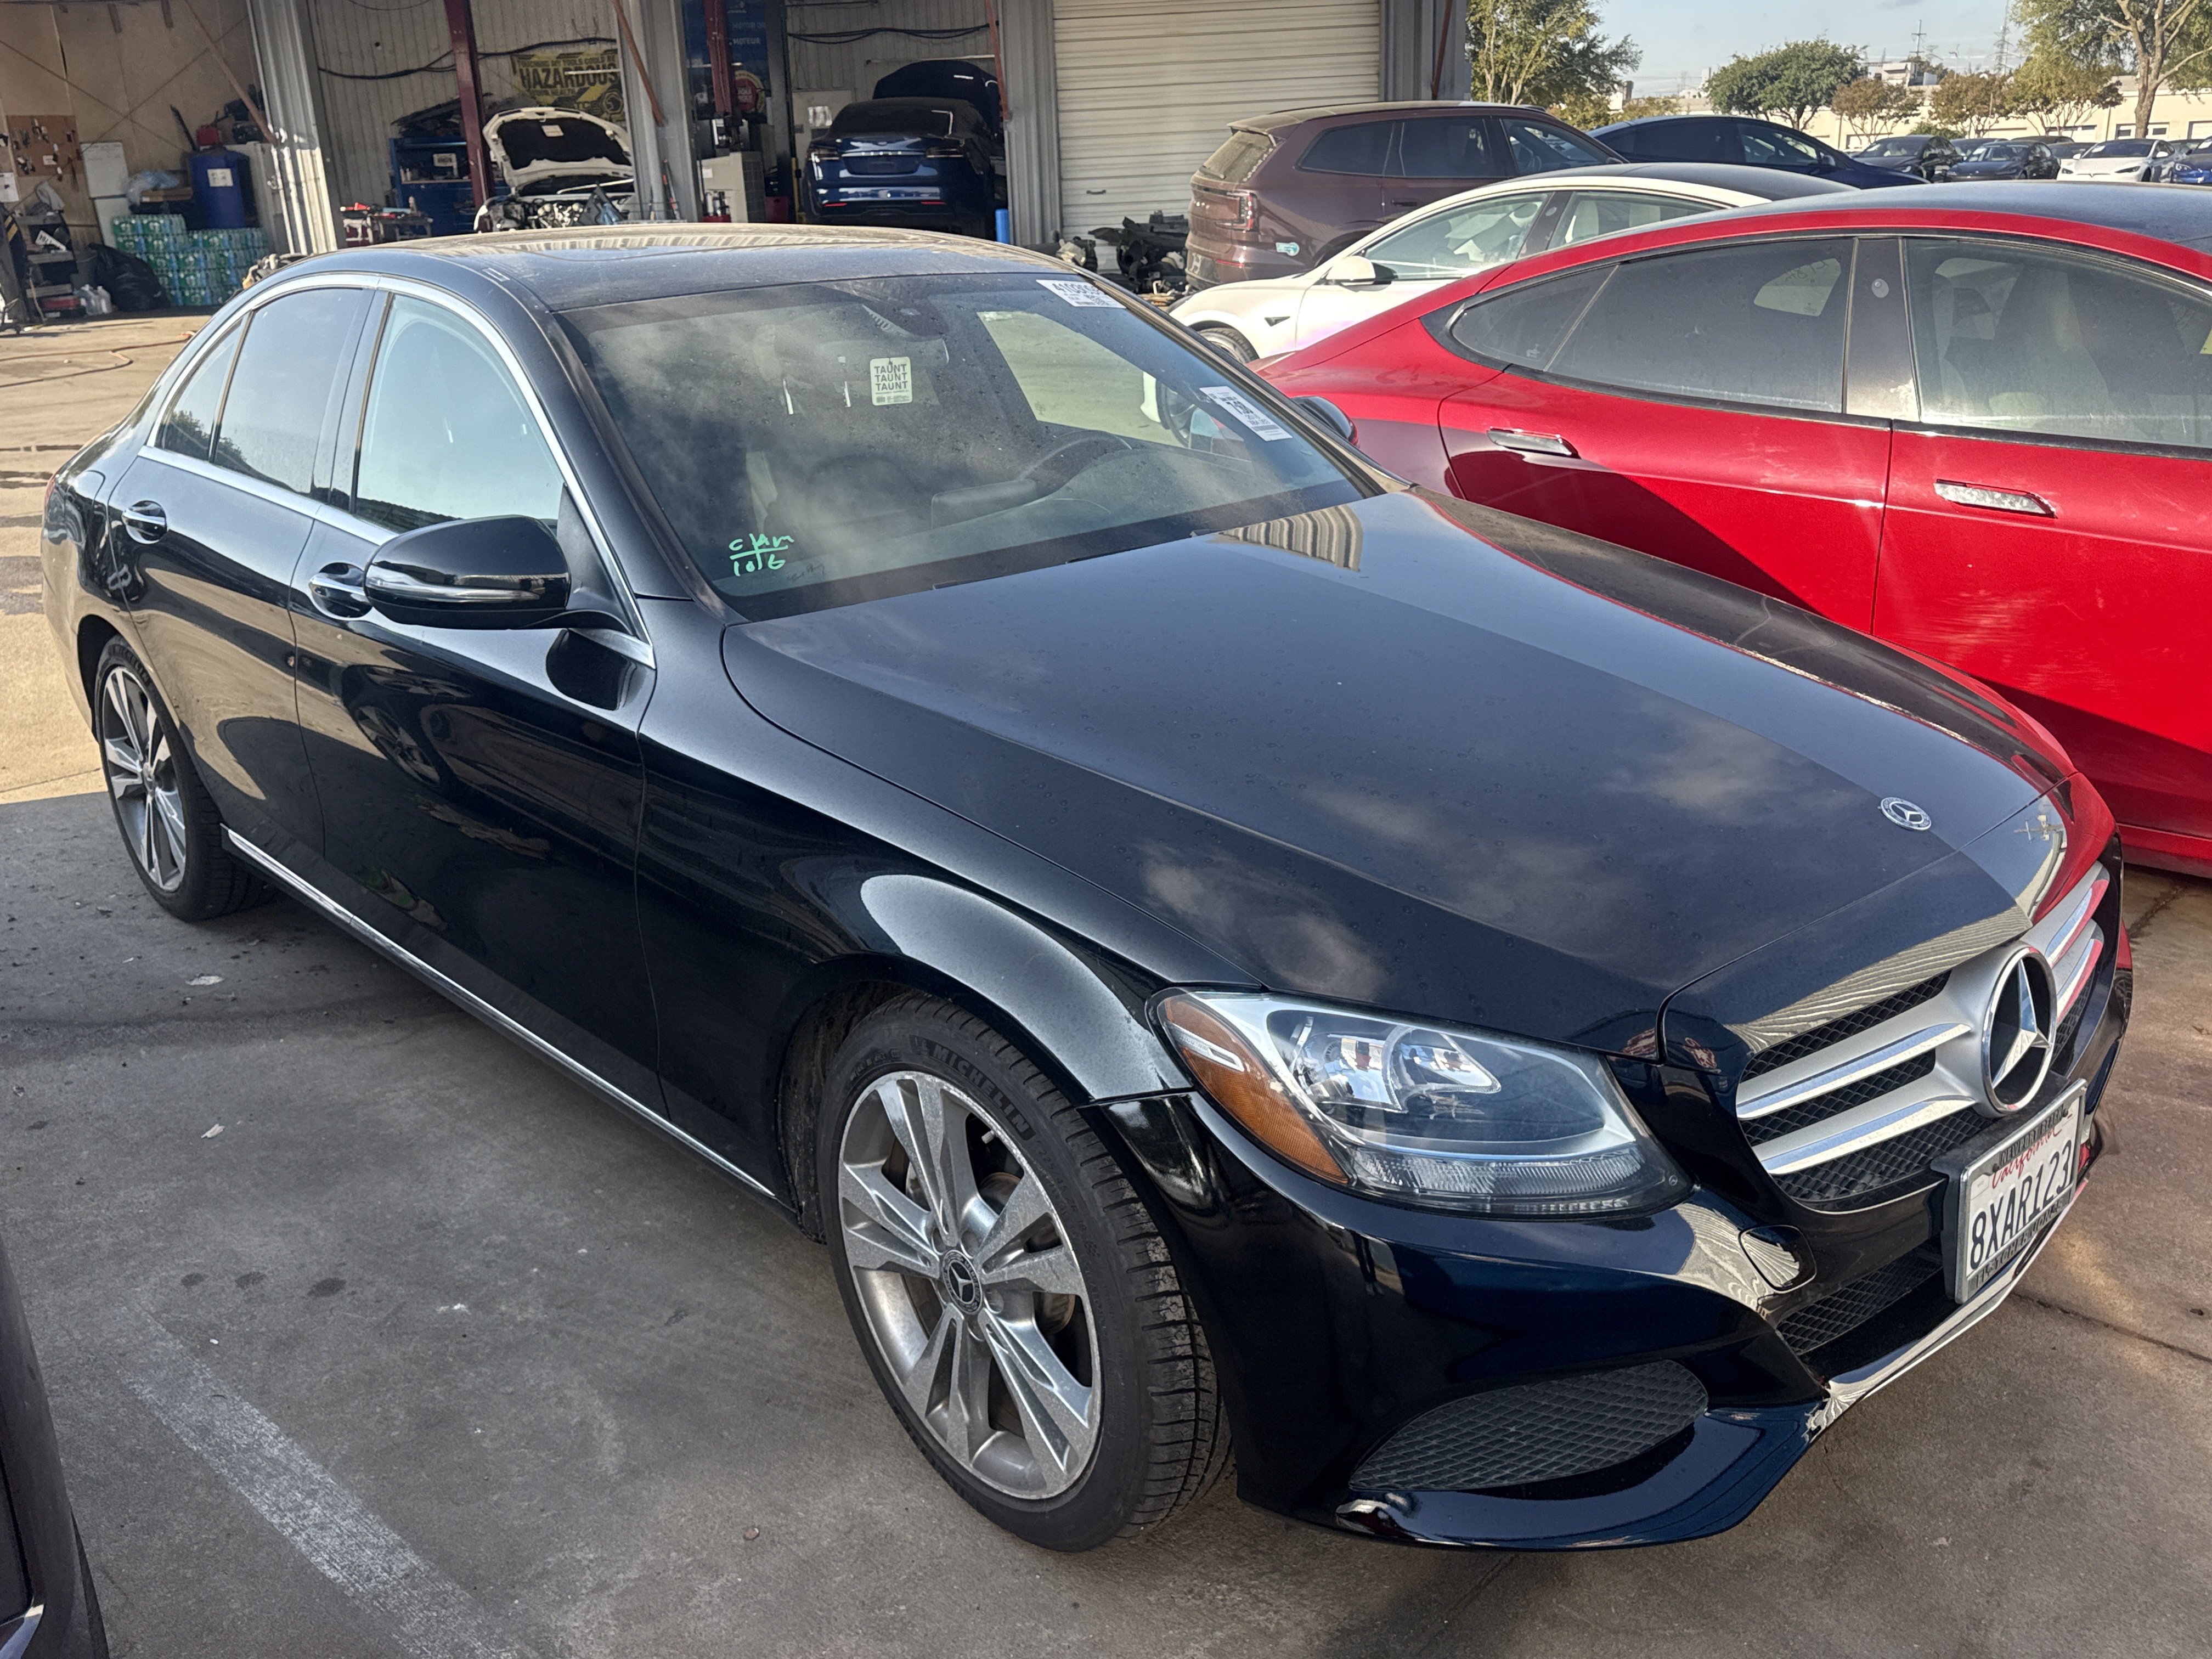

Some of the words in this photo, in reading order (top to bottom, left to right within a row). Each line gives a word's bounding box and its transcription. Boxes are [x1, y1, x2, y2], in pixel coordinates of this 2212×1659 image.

[519, 62, 618, 89] HAZARDOUS
[874, 364, 907, 374] TAUNT
[874, 373, 907, 382] TAUNT
[875, 381, 908, 391] TAUNT
[933, 1044, 1030, 1132] MICHELIN
[2000, 1126, 2040, 1166] NEWPORT
[2040, 1104, 2064, 1135] BEACH
[1971, 1139, 2072, 1270] 8XAR123
